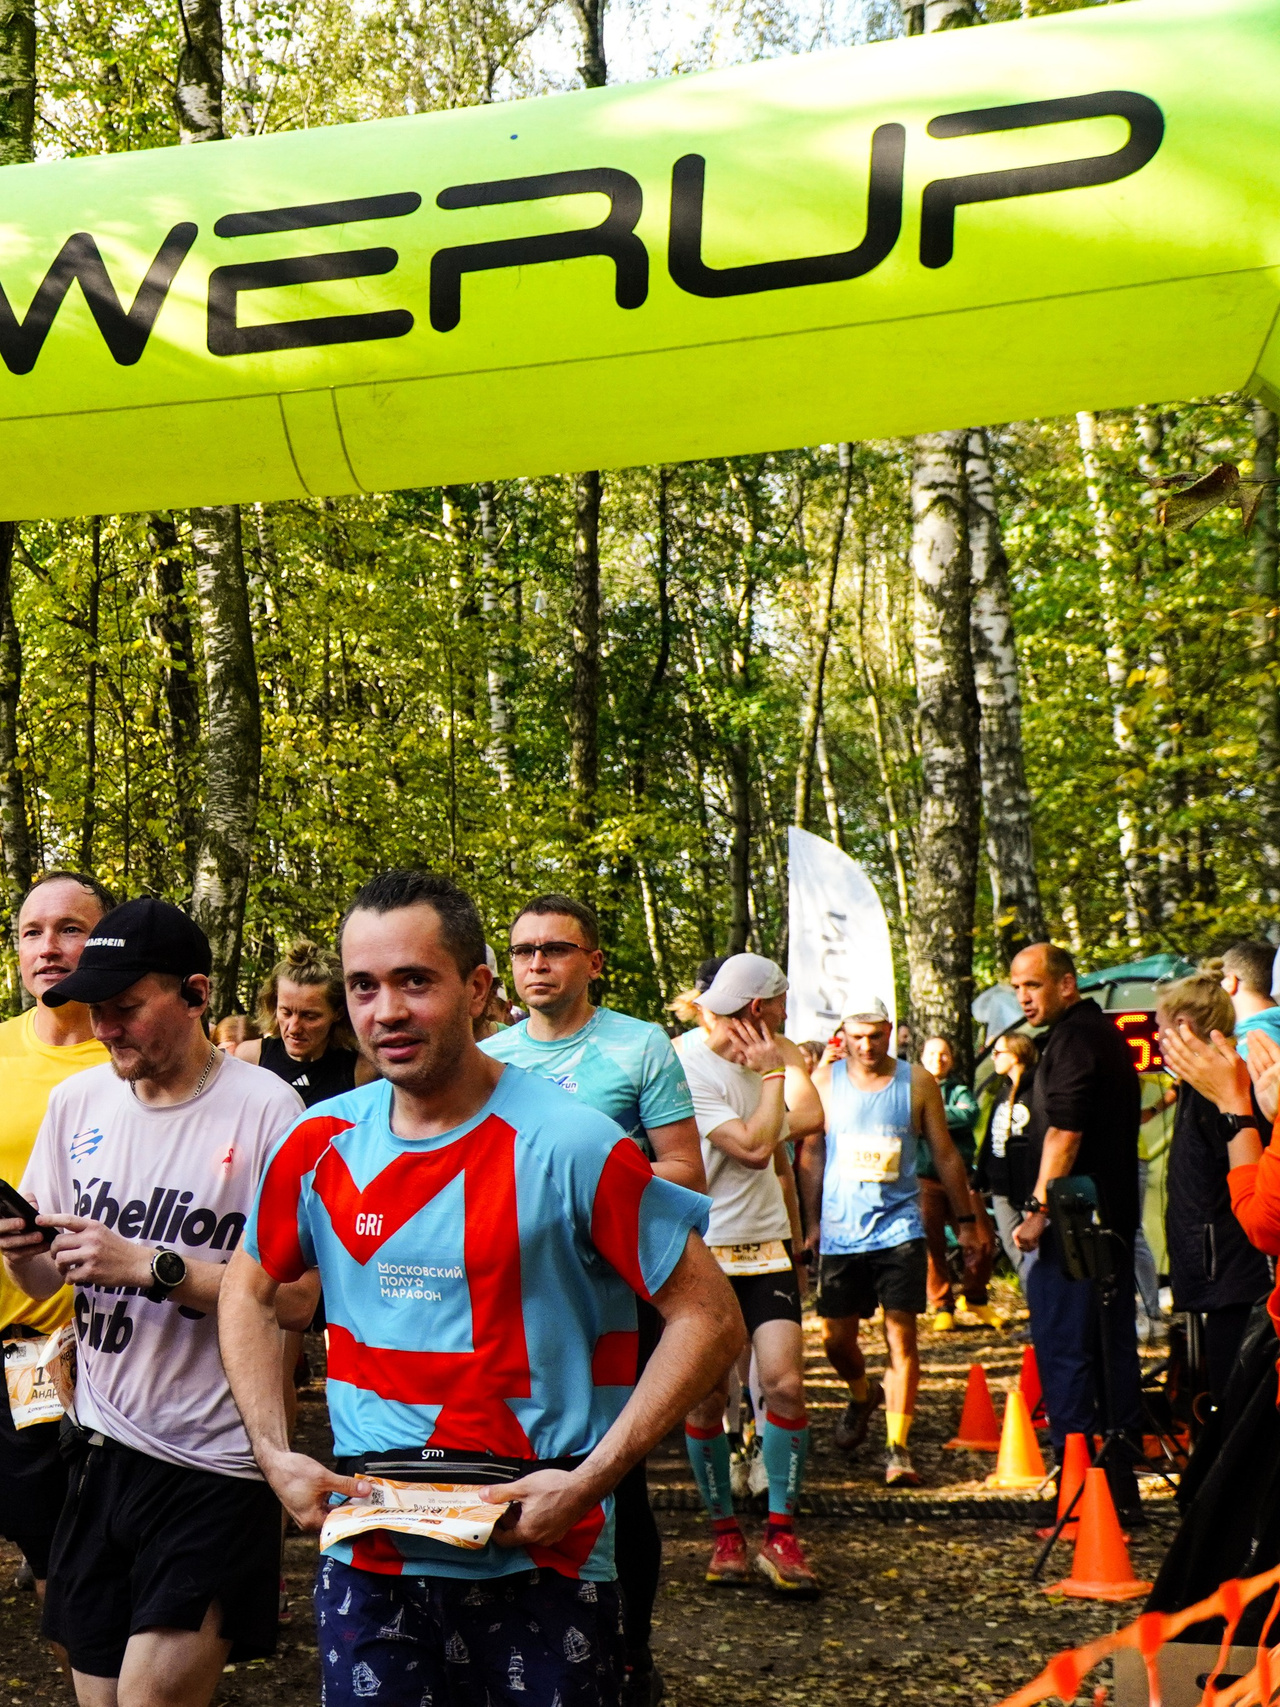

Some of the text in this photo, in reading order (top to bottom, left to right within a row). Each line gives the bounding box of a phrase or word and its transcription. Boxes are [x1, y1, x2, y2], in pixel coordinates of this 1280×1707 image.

[854, 1150, 881, 1163] 109
[355, 1213, 384, 1236] GRi
[377, 1262, 464, 1279] МОСКОВСКИЙ
[379, 1276, 413, 1287] ПОЛУ
[380, 1288, 442, 1301] МАРАФОН
